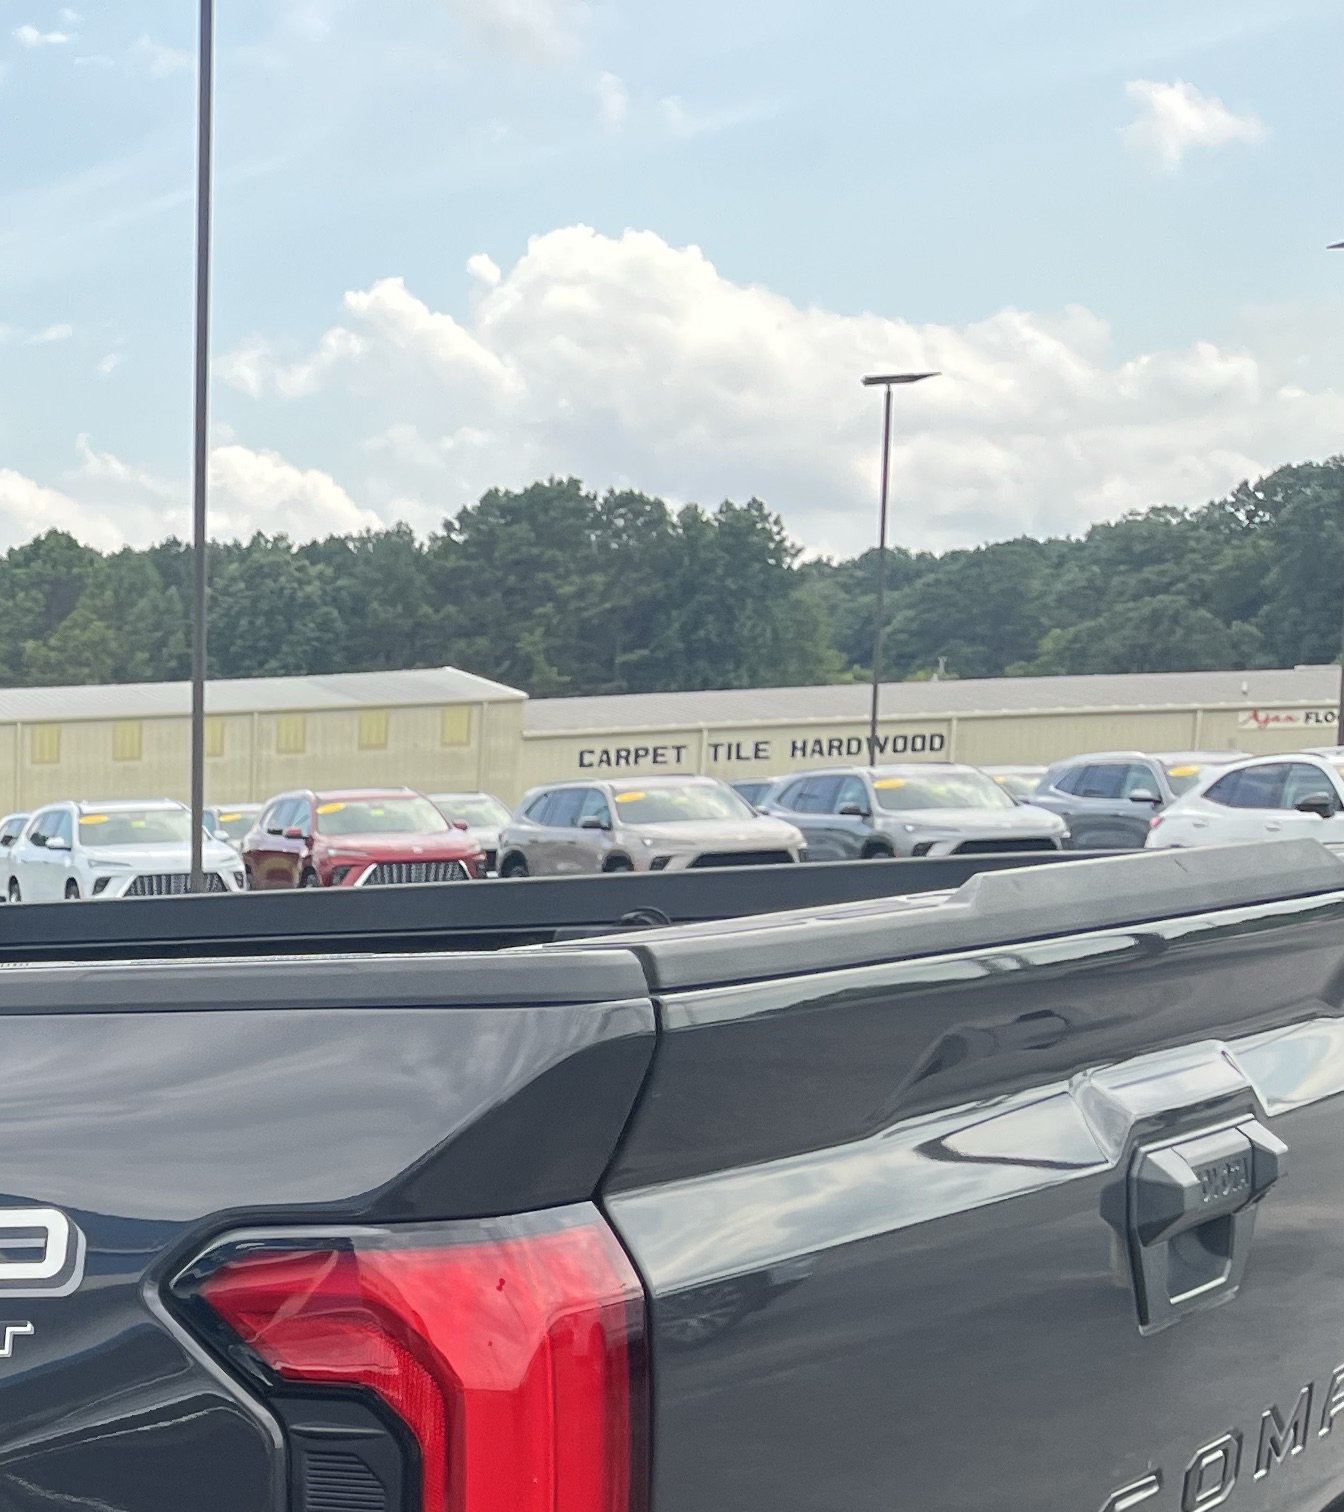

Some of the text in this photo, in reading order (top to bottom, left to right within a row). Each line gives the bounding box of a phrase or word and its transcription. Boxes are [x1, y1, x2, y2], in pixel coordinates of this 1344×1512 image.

[1303, 710, 1339, 724] FLO
[578, 733, 945, 769] CARPET TILE HARDWOOD
